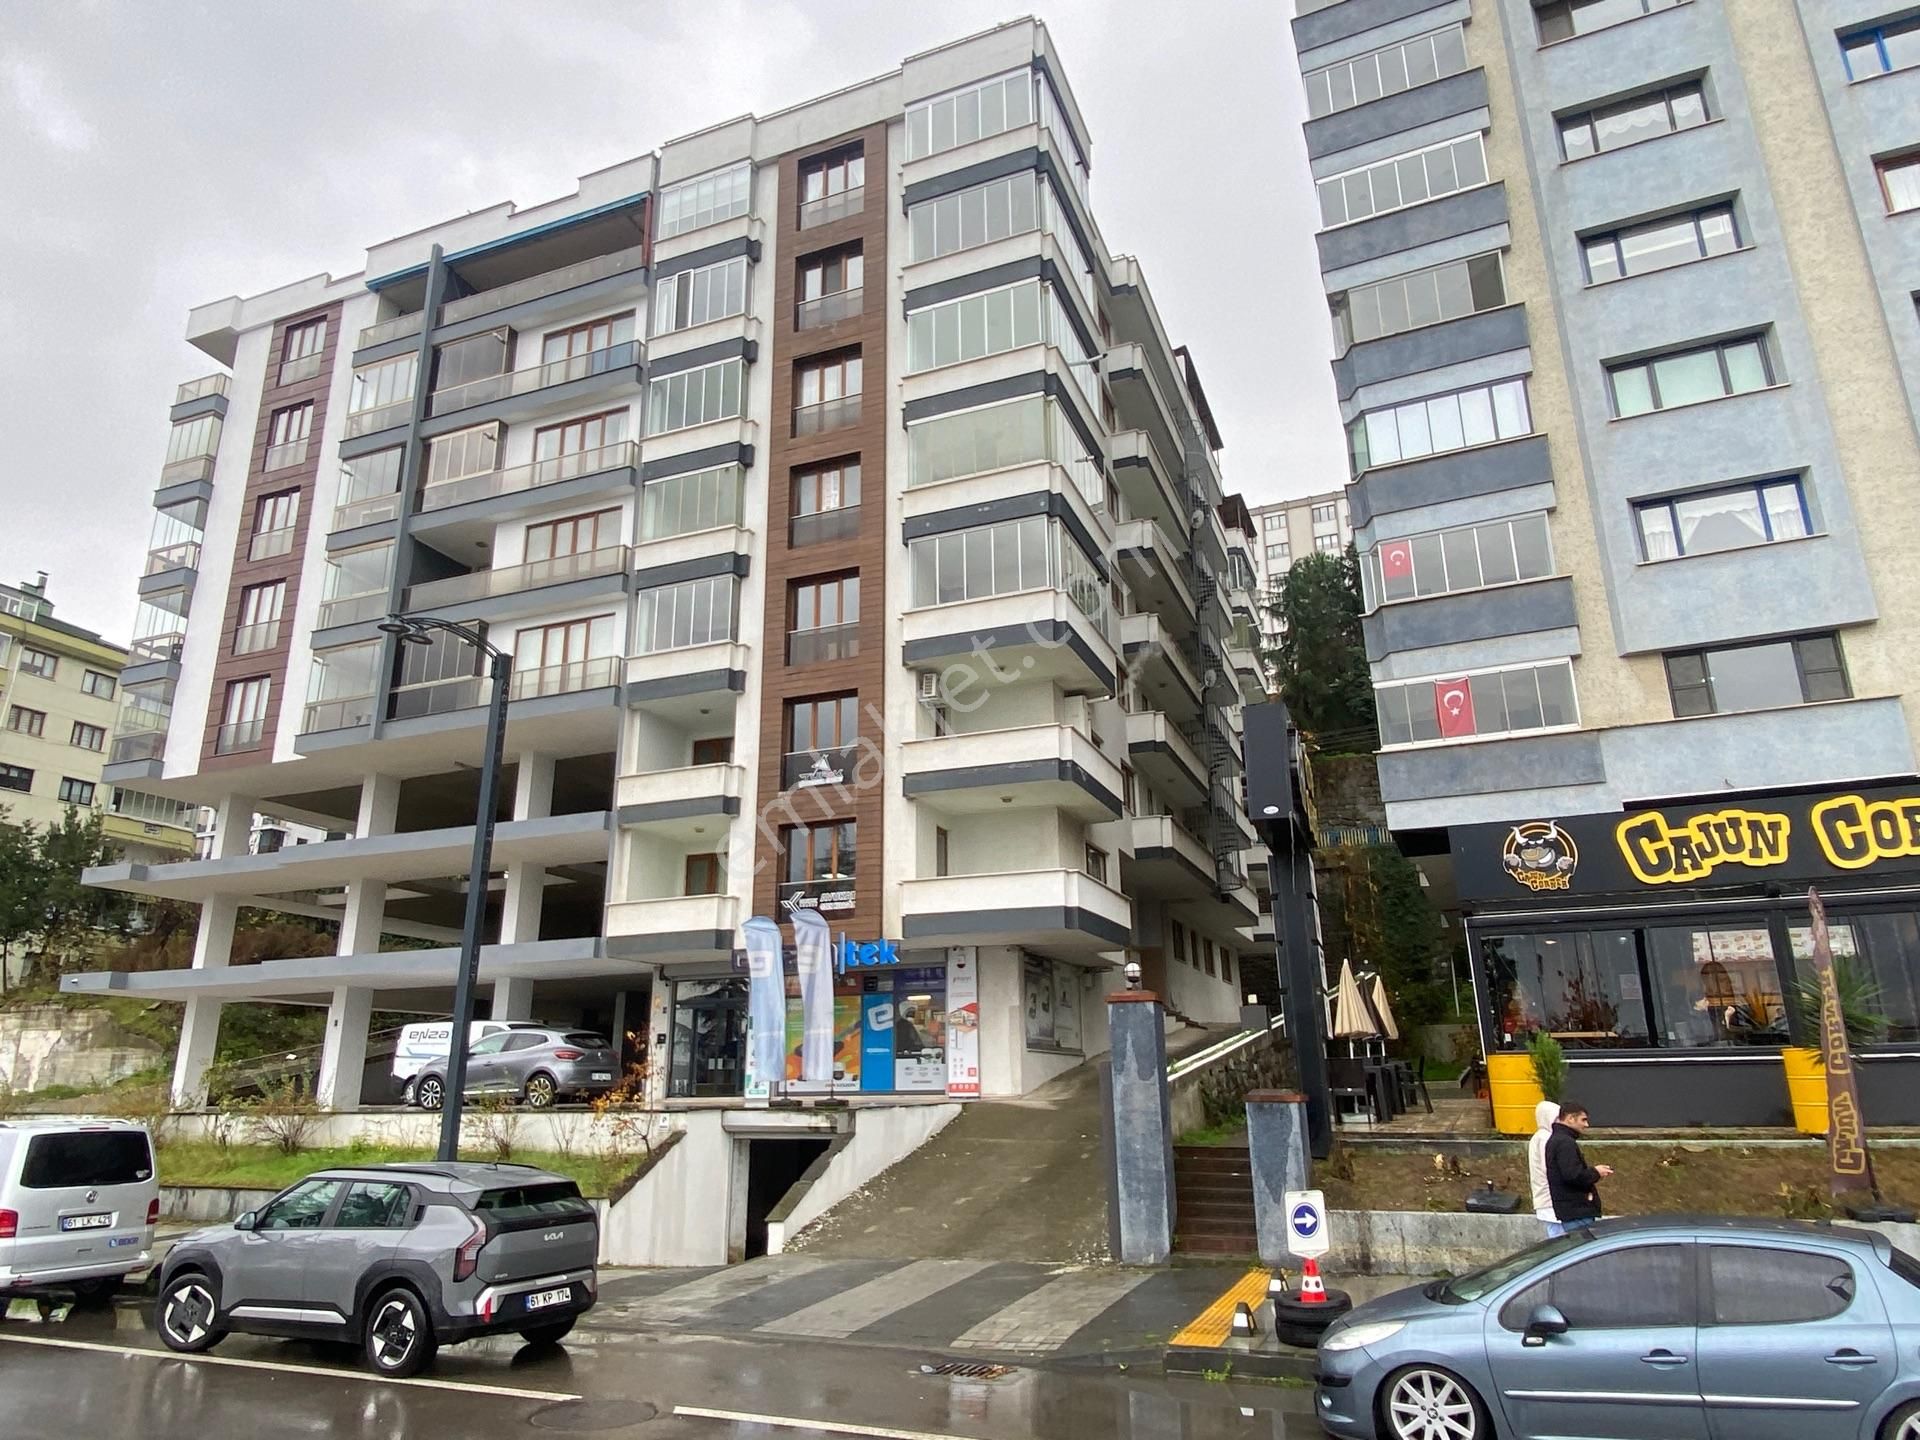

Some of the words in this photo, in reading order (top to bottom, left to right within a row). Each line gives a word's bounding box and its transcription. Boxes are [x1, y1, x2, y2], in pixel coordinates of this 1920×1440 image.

[1620, 813, 1787, 880] CAJUN
[68, 1218, 77, 1227] 61
[530, 1295, 539, 1307] 61
[543, 1293, 553, 1304] KP
[557, 1289, 570, 1301] 174
